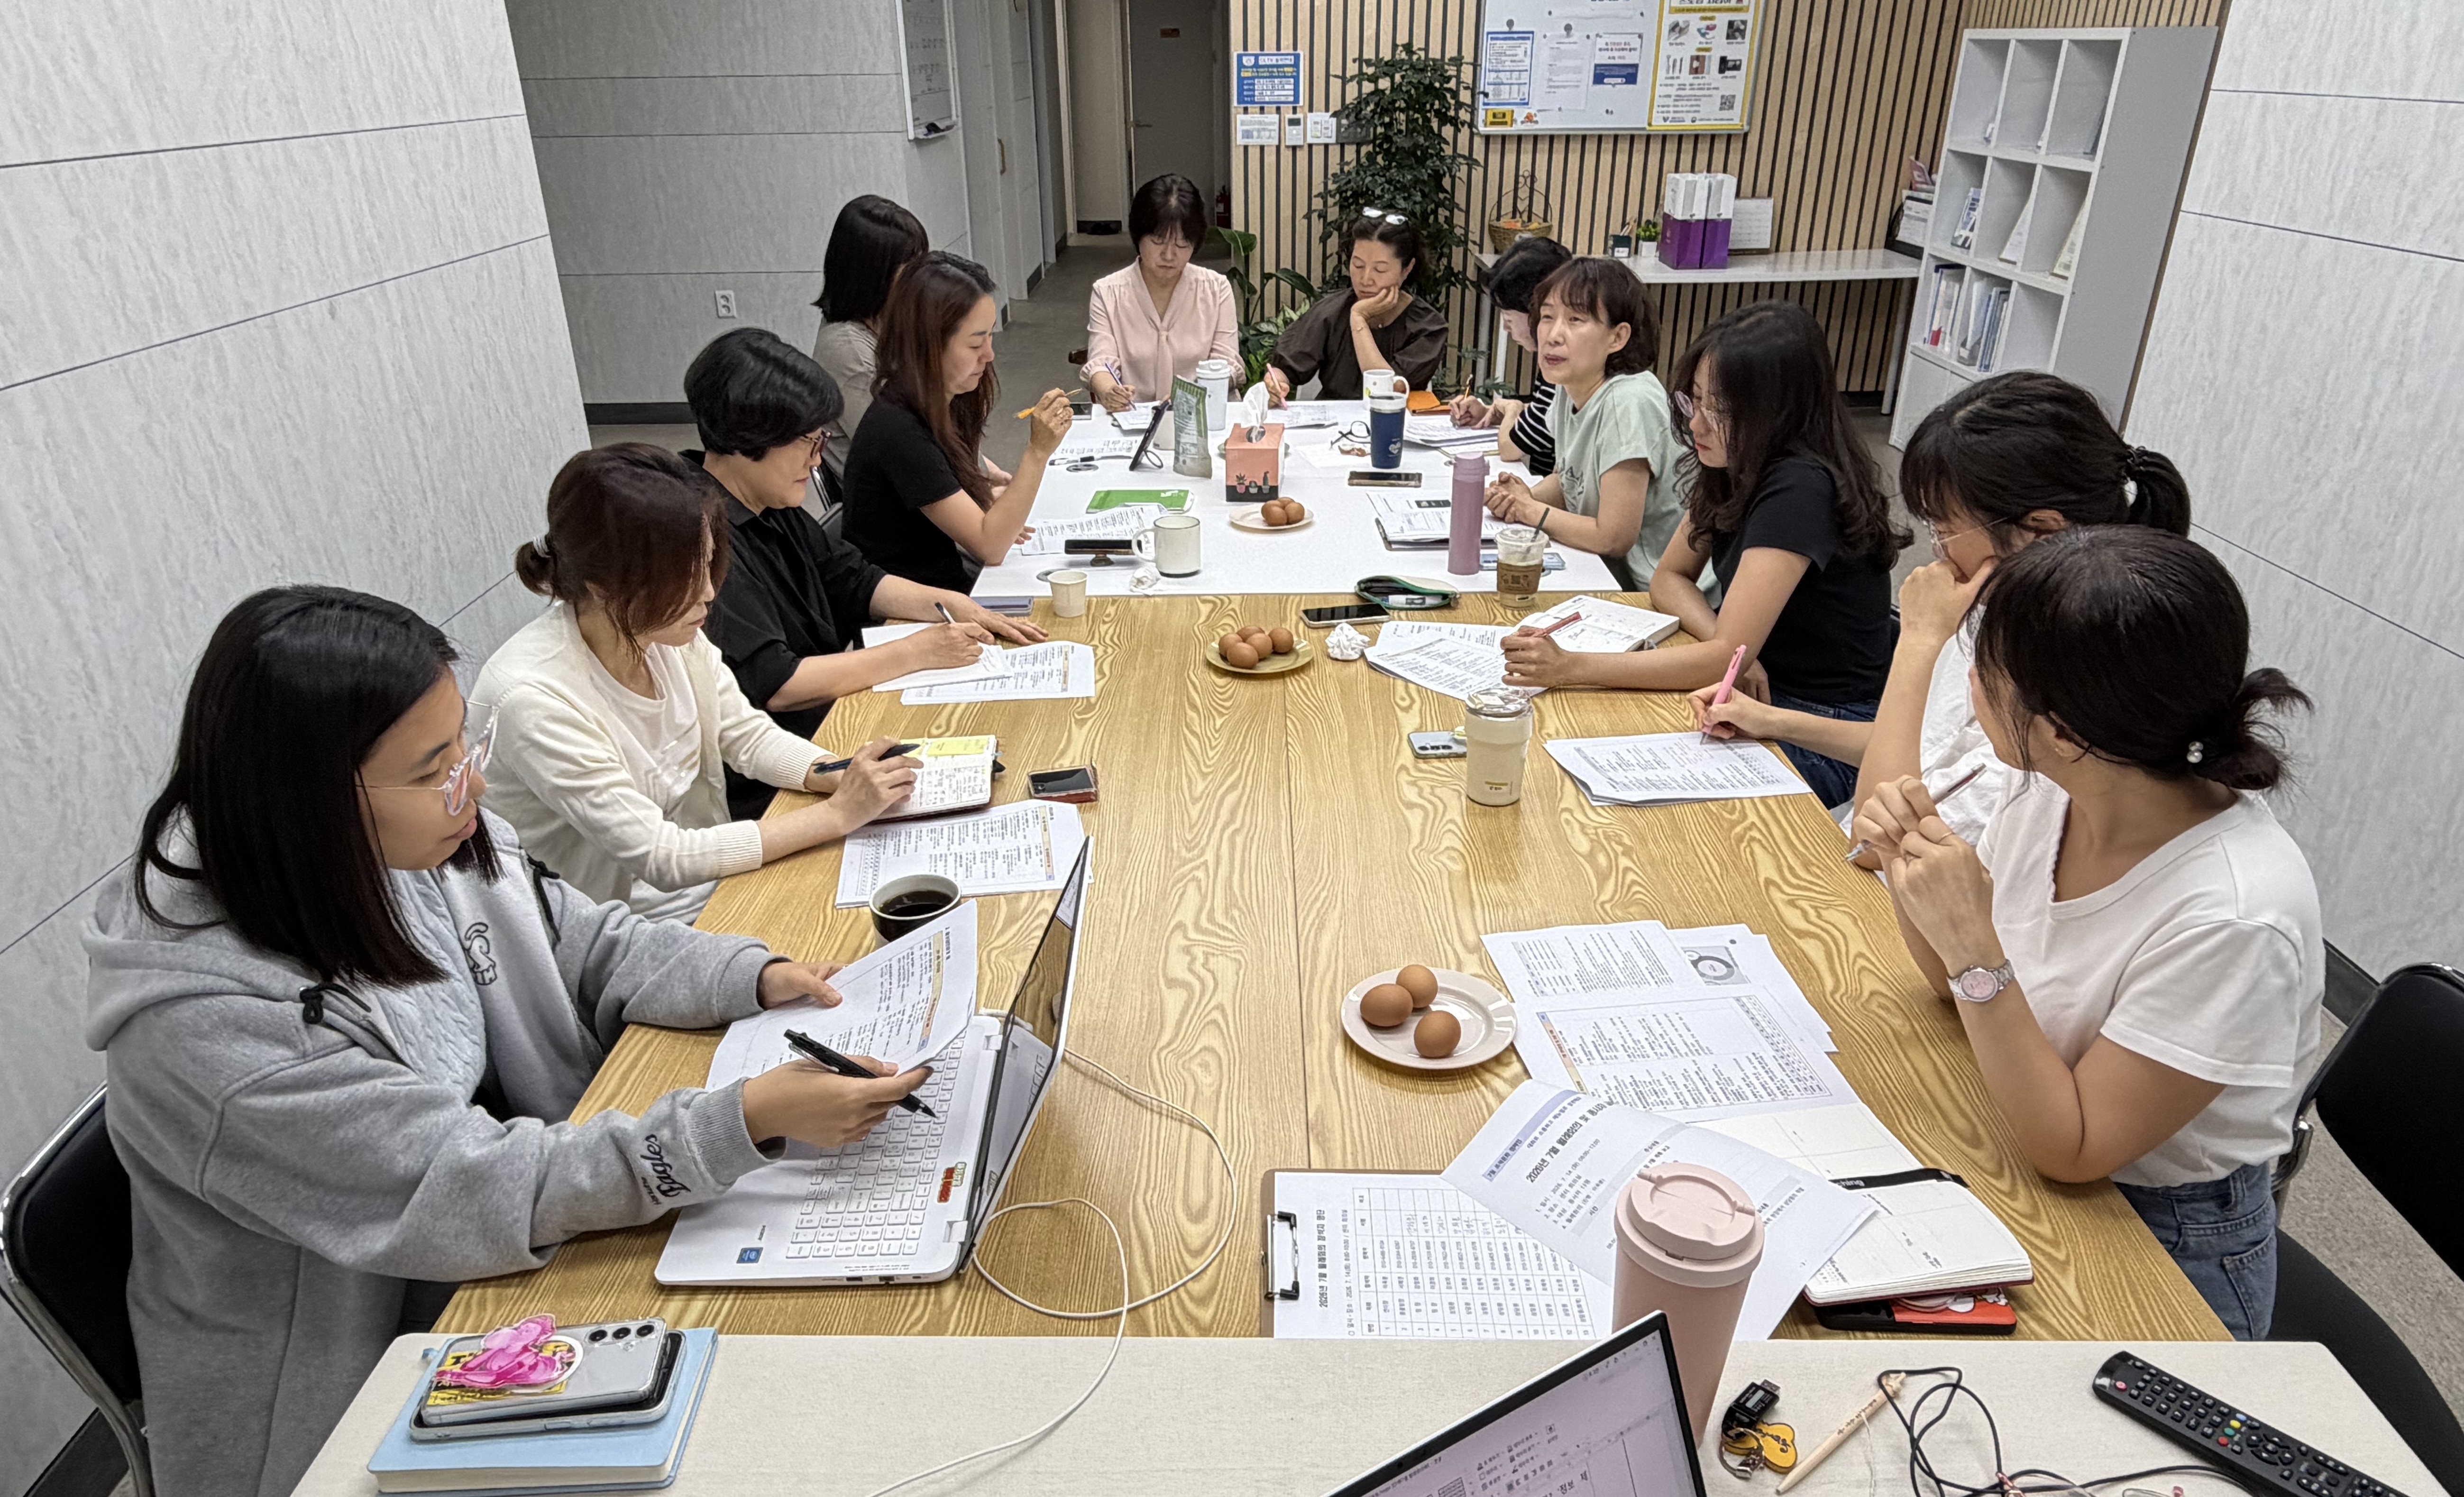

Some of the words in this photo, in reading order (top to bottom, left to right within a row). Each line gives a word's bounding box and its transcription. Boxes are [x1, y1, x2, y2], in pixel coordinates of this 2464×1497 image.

[640, 1134, 691, 1197] Eagles
[1526, 1158, 1550, 1183] 2026년
[1546, 1146, 1560, 1159] 7월
[1557, 1121, 1583, 1146] 월례회의
